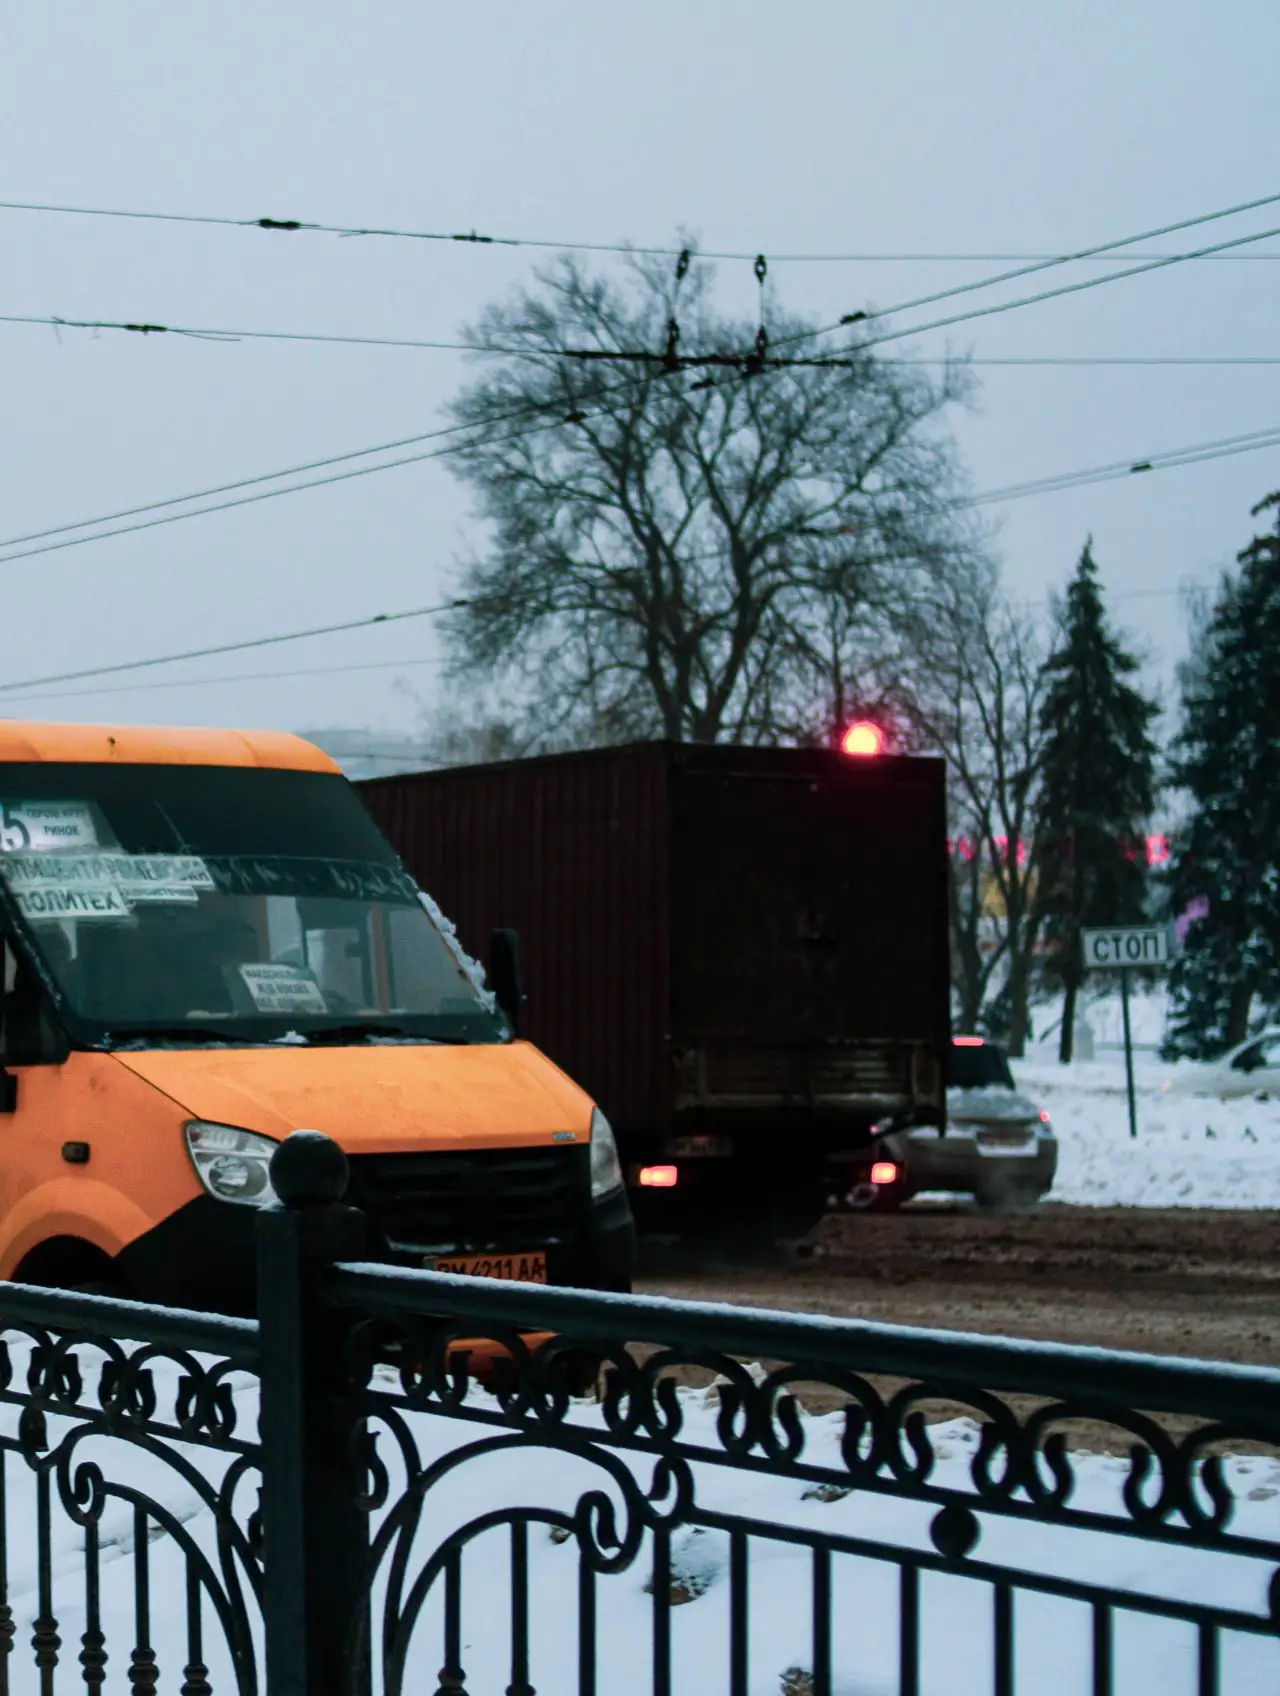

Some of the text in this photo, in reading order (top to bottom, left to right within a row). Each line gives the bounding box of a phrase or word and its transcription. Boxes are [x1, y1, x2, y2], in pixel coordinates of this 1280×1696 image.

[44, 825, 79, 836] РИНОК
[17, 890, 120, 913] ПОЛИТЕХ
[1094, 934, 1158, 961] СТОП
[470, 1259, 513, 1281] 4211
